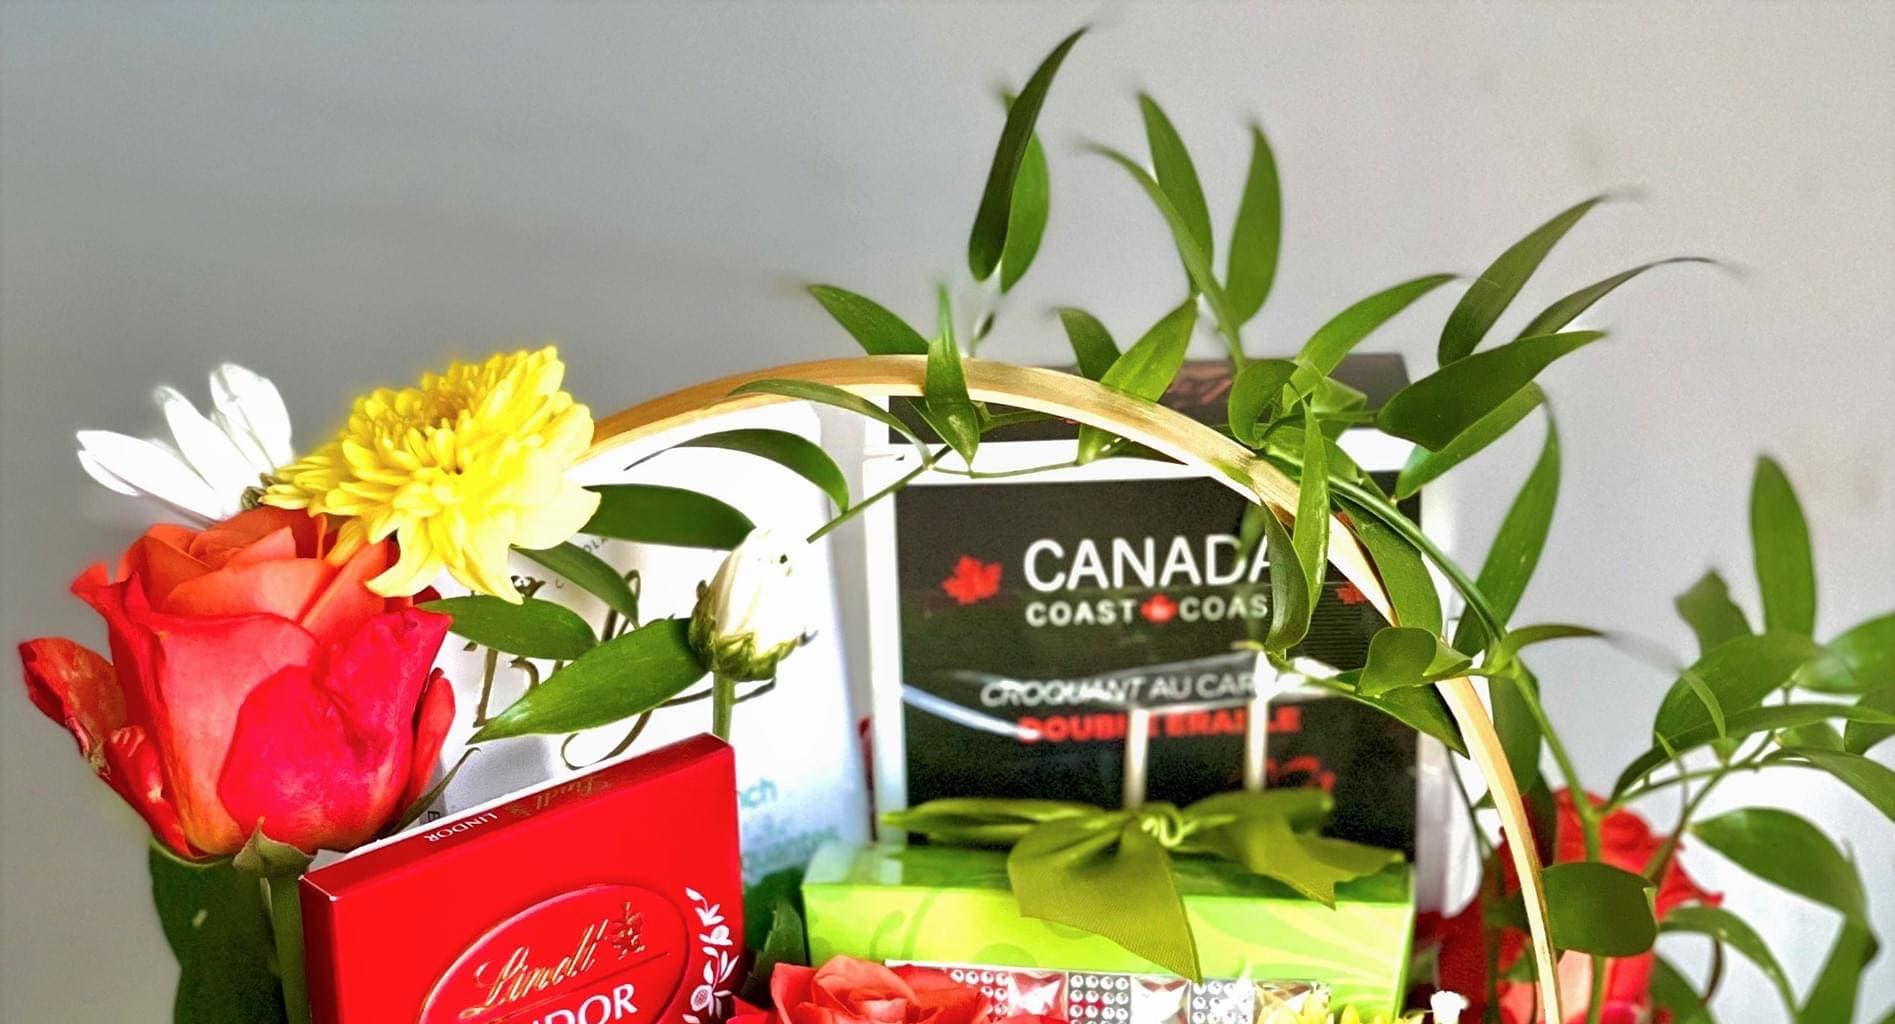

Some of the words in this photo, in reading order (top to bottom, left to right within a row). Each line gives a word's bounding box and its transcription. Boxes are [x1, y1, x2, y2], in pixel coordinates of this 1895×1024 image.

[1025, 598, 1137, 628] COAST
[1178, 594, 1268, 622] COAS
[1150, 673, 1193, 700] AU
[424, 811, 498, 842] LINDOR
[458, 918, 609, 1020] Lindt
